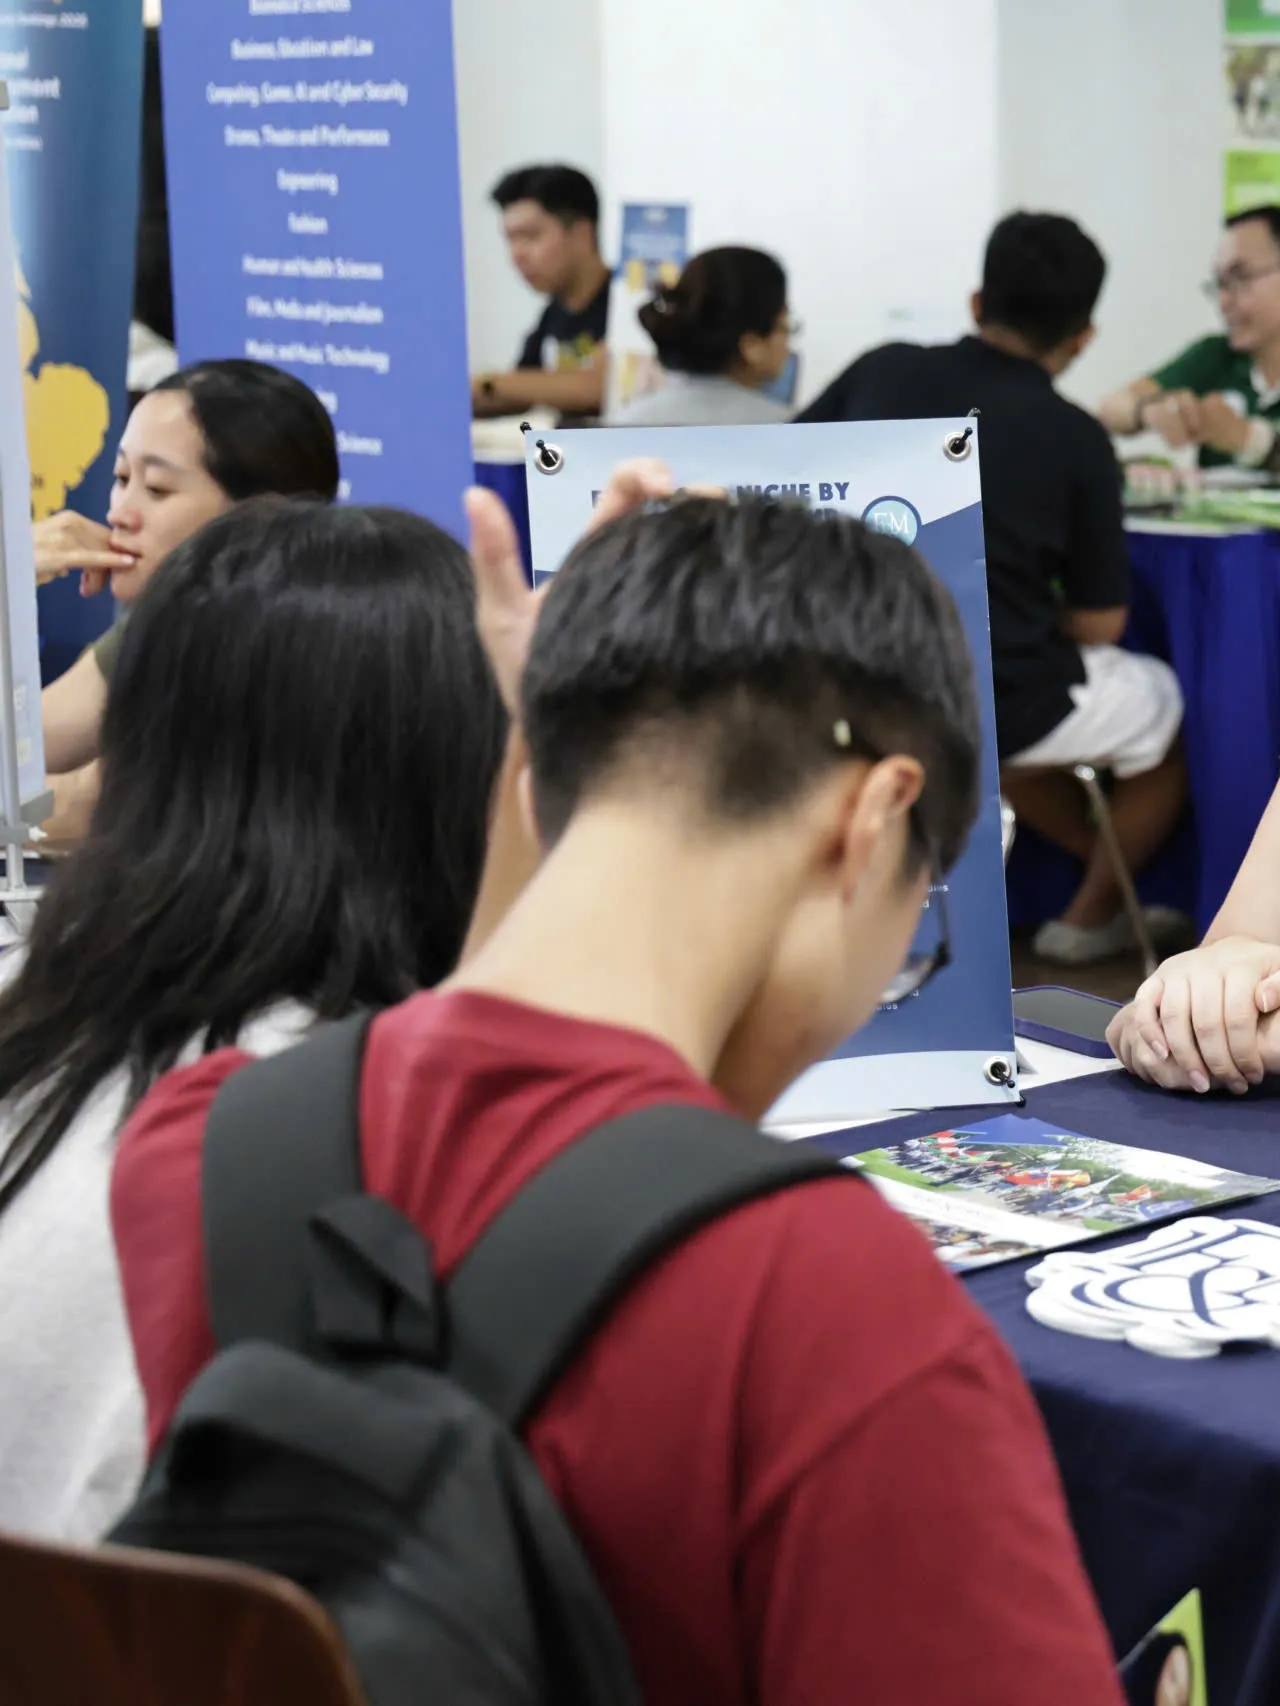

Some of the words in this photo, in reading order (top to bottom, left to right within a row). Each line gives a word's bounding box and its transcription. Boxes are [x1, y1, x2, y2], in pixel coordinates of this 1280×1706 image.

[330, 35, 353, 57] and
[308, 81, 331, 103] and
[365, 79, 408, 107] Security
[318, 123, 390, 147] Performance
[276, 168, 338, 196] Engineering
[334, 257, 384, 280] Sciences
[326, 343, 390, 375] Technology
[819, 482, 850, 502] BY
